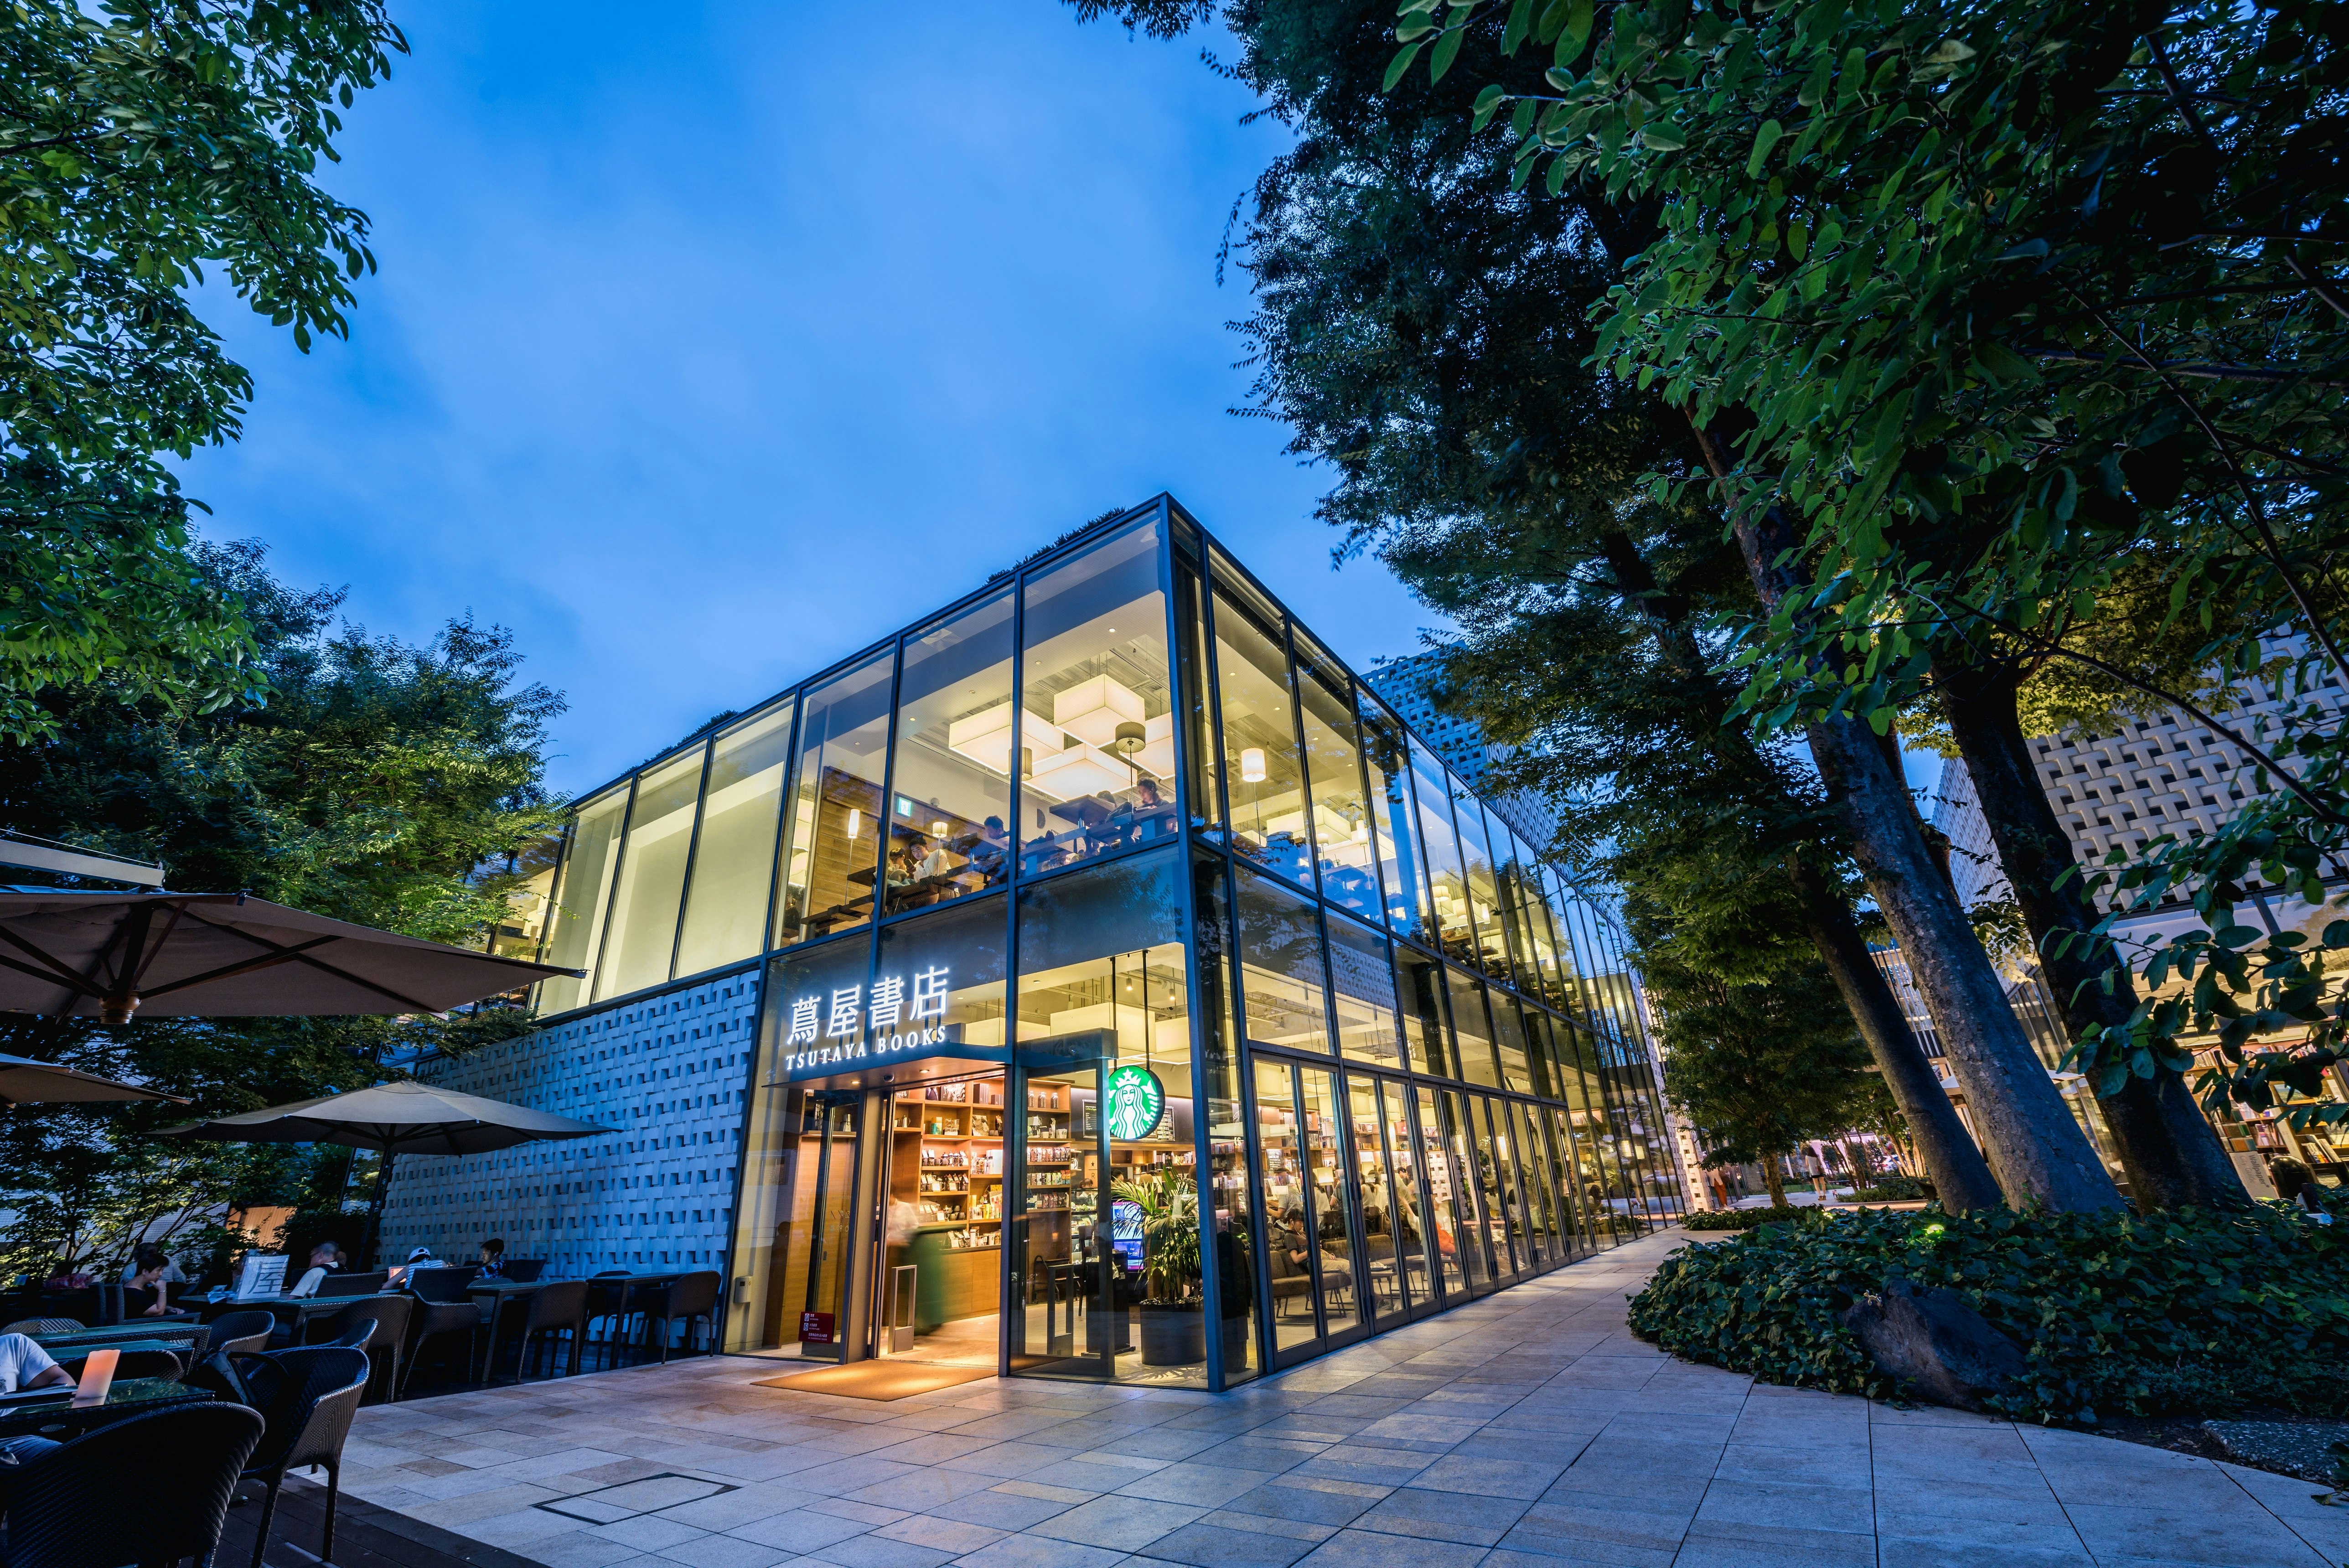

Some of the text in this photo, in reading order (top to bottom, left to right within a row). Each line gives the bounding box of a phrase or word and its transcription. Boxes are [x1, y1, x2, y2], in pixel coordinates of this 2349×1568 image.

[787, 966, 949, 1045] 蔦屋書店
[786, 1026, 946, 1070] TSUTAYA BOOKS
[2239, 1155, 2248, 1166] City
[2245, 1168, 2256, 1184] Guide
[247, 1261, 288, 1294] 屋
